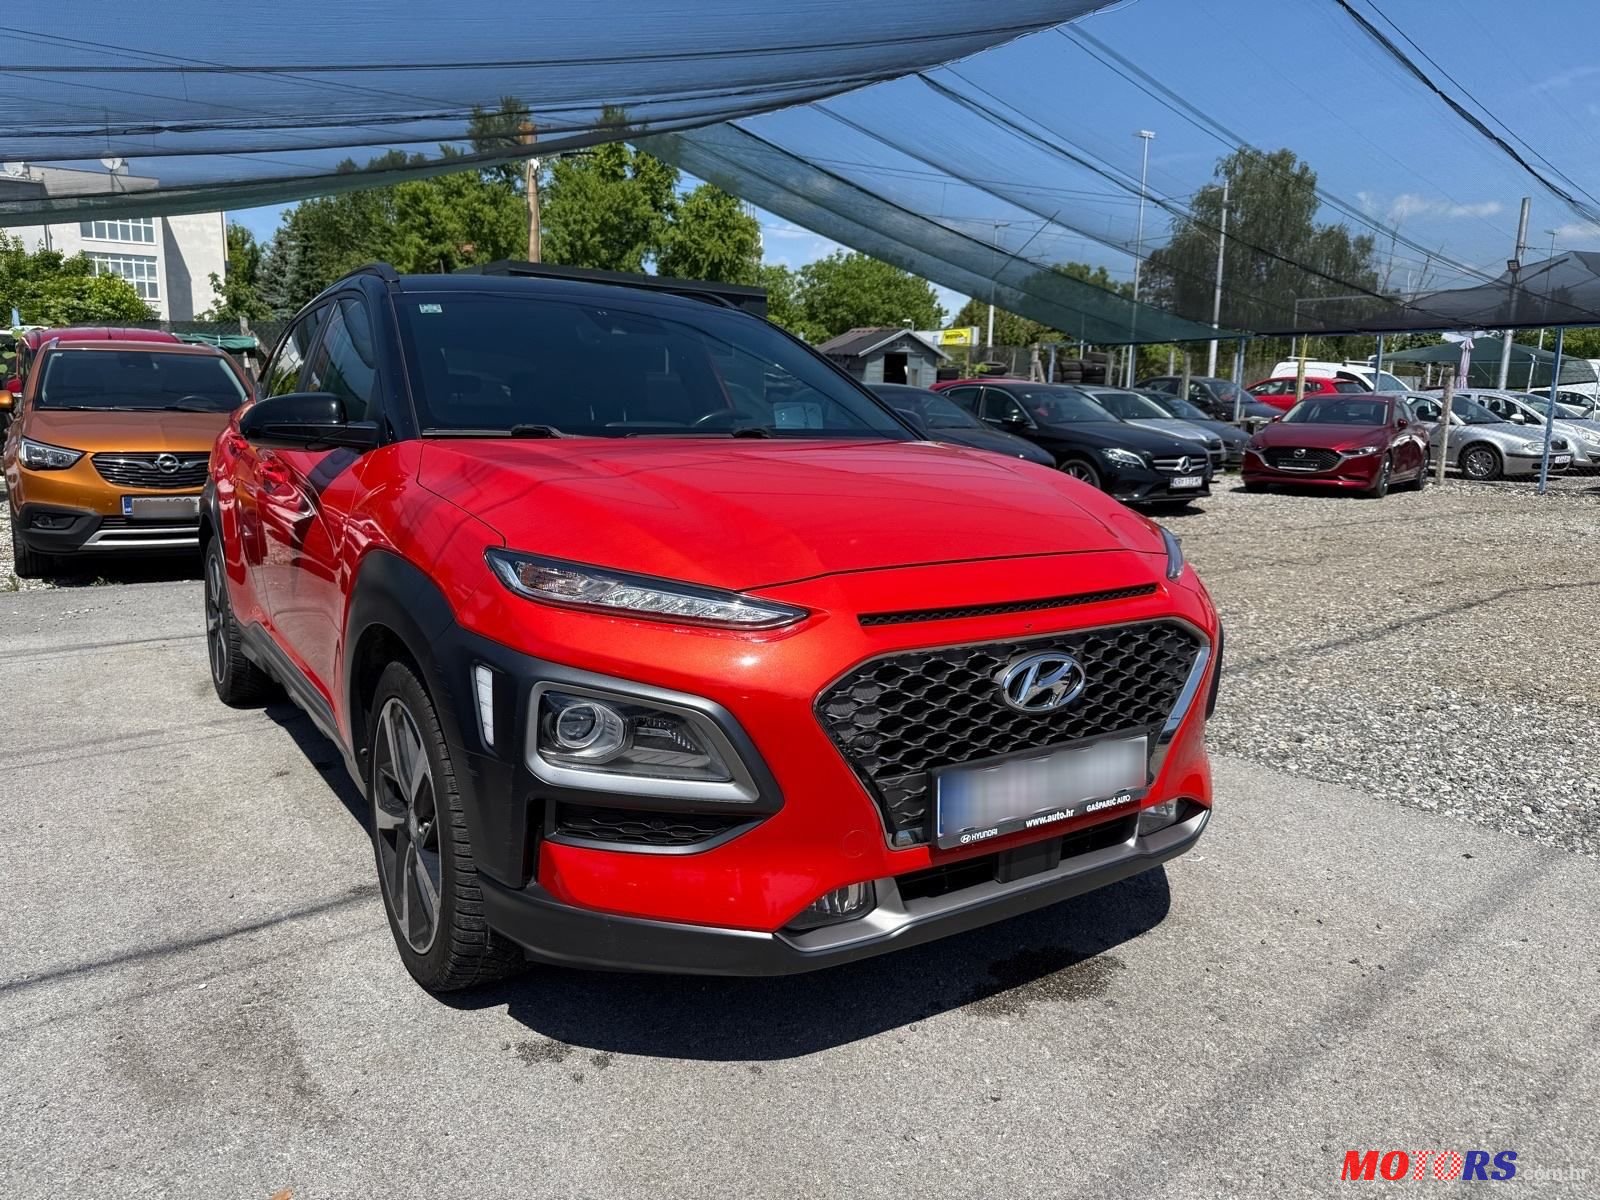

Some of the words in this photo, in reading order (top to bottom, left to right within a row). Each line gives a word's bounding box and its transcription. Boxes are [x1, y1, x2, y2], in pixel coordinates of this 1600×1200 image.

[971, 828, 998, 841] HYUNDAI
[1025, 808, 1075, 828] www.auto.hr
[1116, 794, 1131, 804] AUTO
